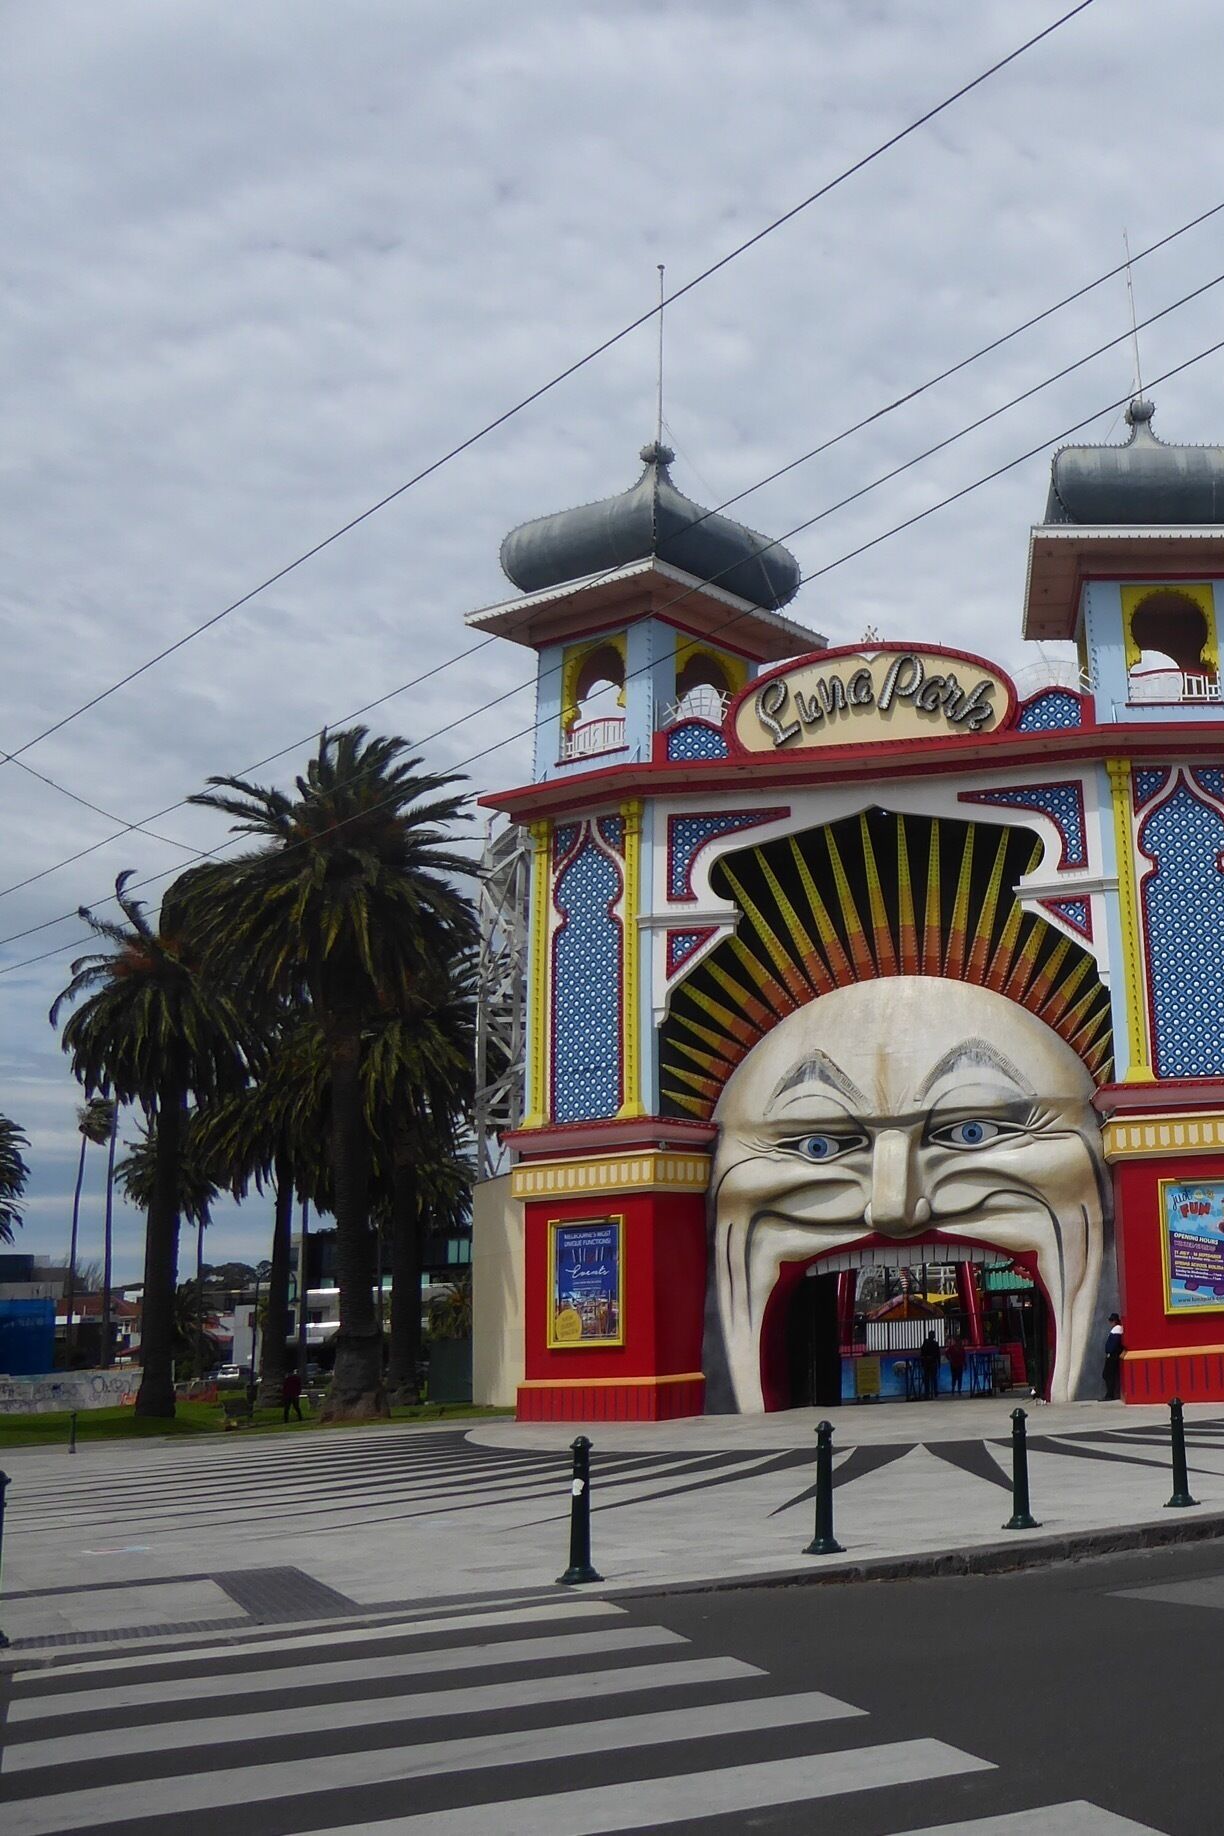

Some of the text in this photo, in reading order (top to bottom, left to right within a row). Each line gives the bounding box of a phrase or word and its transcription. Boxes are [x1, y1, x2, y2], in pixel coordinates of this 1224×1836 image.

[755, 653, 994, 747] Luna Park
[1180, 1201, 1211, 1218] FUN
[1173, 1232, 1199, 1242] OPENING
[1199, 1236, 1219, 1246] HOURS
[565, 1264, 610, 1279] Events
